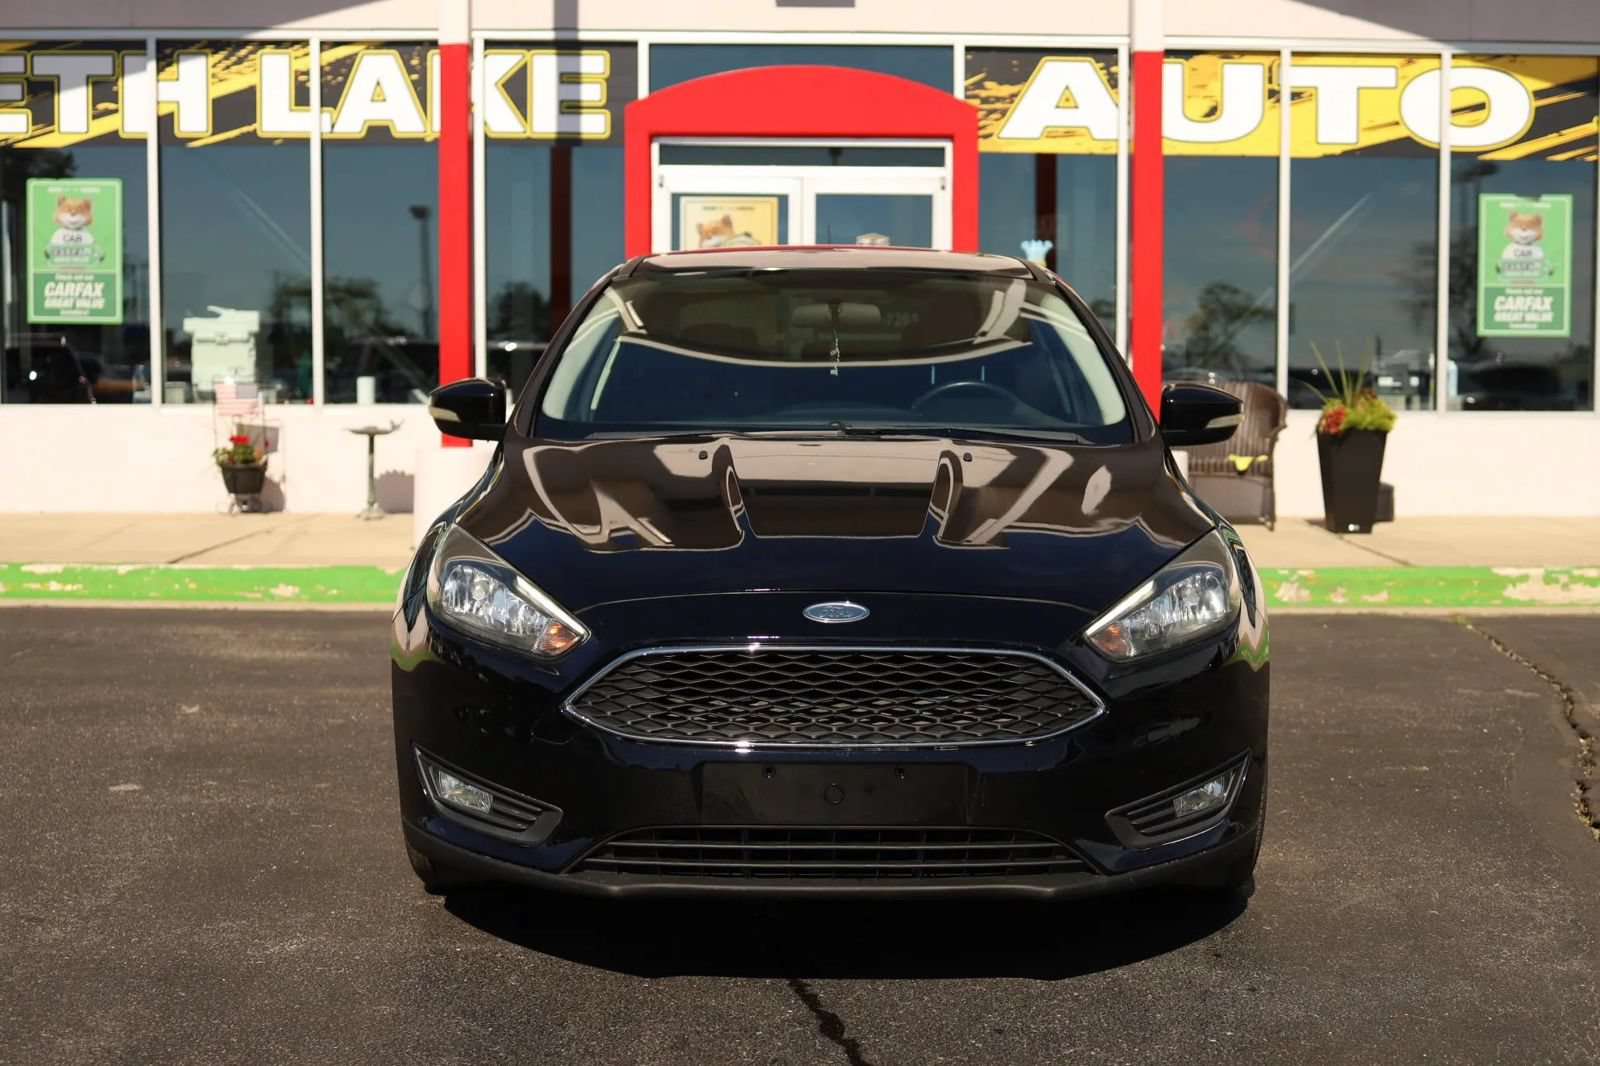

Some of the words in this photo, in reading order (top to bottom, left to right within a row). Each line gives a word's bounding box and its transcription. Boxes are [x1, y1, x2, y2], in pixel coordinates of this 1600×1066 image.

[256, 49, 611, 139] LAKE
[996, 56, 1536, 151] AUTO
[44, 281, 105, 297] CARFAX
[1494, 295, 1554, 311] CARFAX
